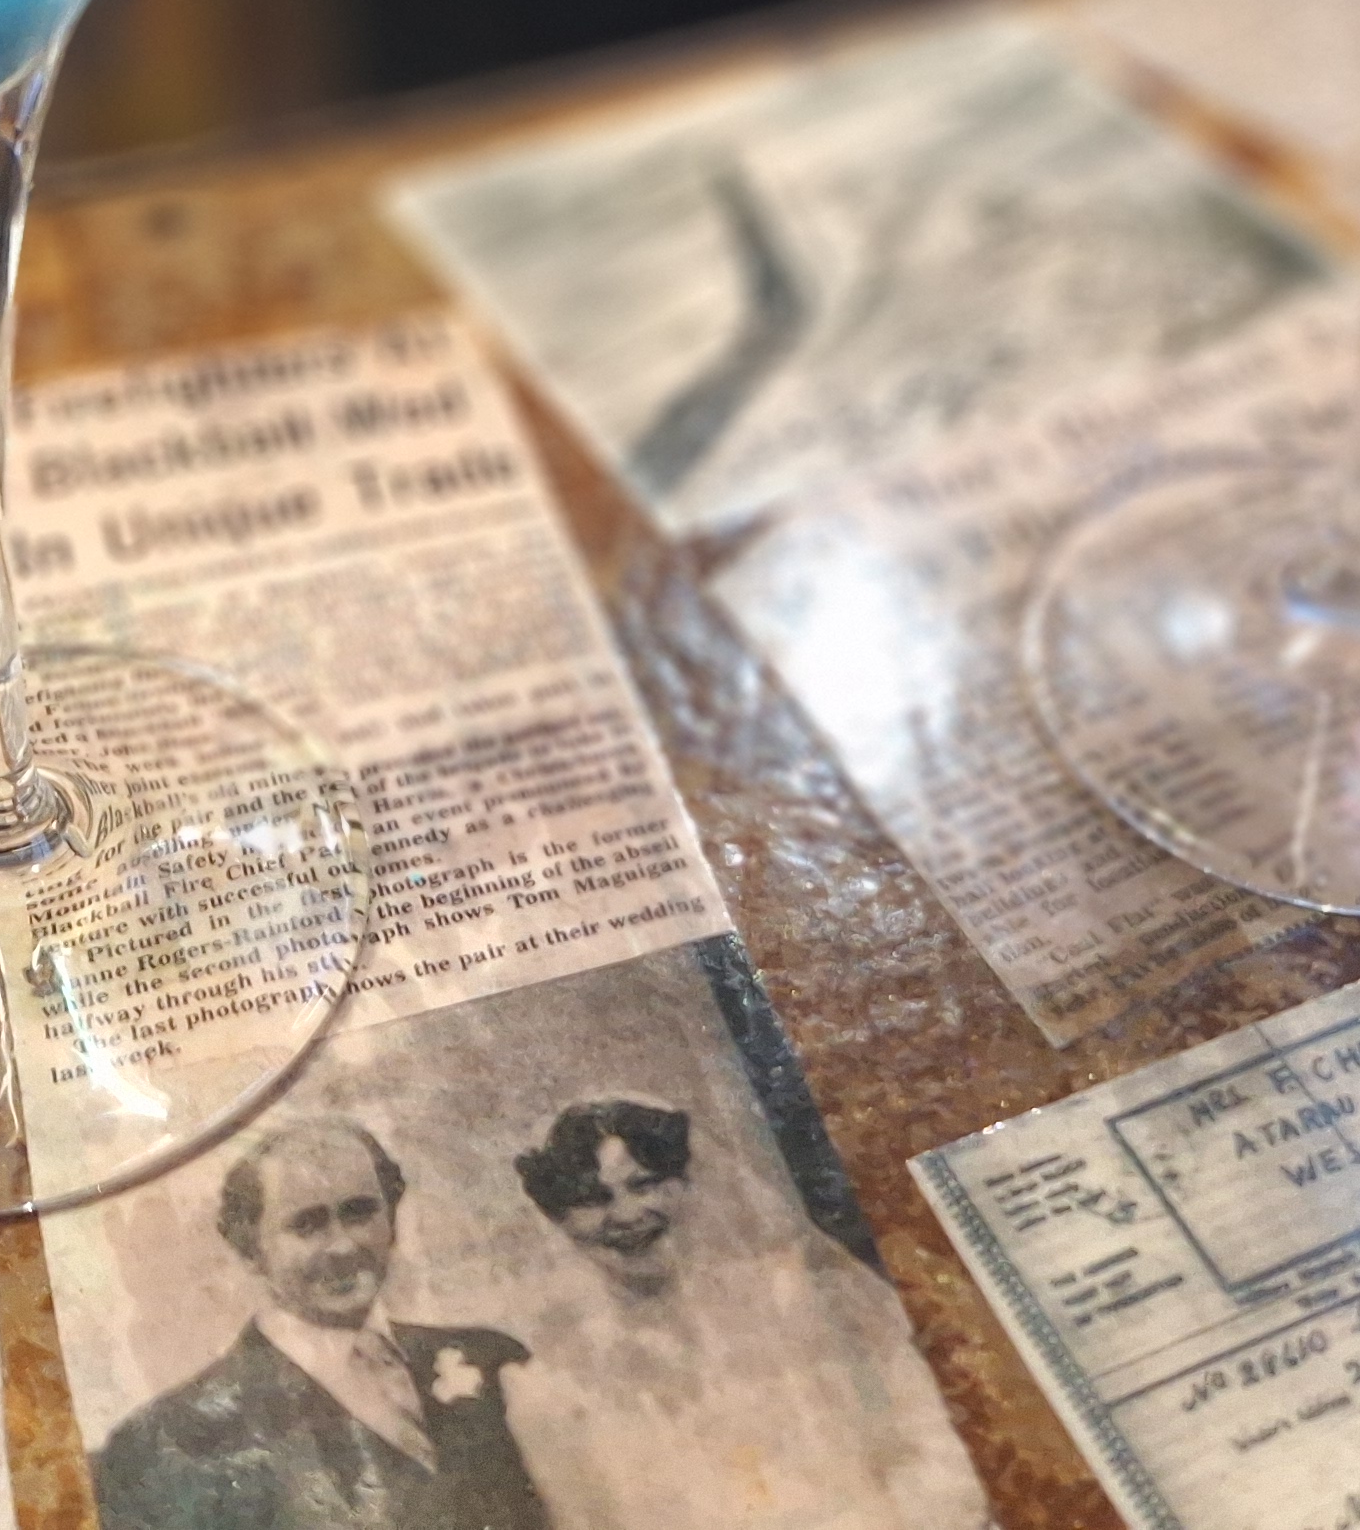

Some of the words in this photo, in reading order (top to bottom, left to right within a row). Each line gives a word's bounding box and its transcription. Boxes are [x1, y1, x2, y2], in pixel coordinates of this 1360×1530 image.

[87, 923, 193, 964] Pictured
[209, 914, 231, 930] in
[509, 849, 528, 868] is
[542, 838, 578, 858] the
[420, 870, 536, 909] beginning
[542, 858, 564, 880] of
[570, 852, 607, 872] the
[424, 901, 495, 931] shows
[507, 885, 561, 910] Tom
[131, 1017, 177, 1041] last
[414, 956, 451, 978] the
[459, 942, 506, 971] pair
[514, 936, 539, 954] at
[545, 919, 601, 946] their
[608, 896, 706, 931] wedding
